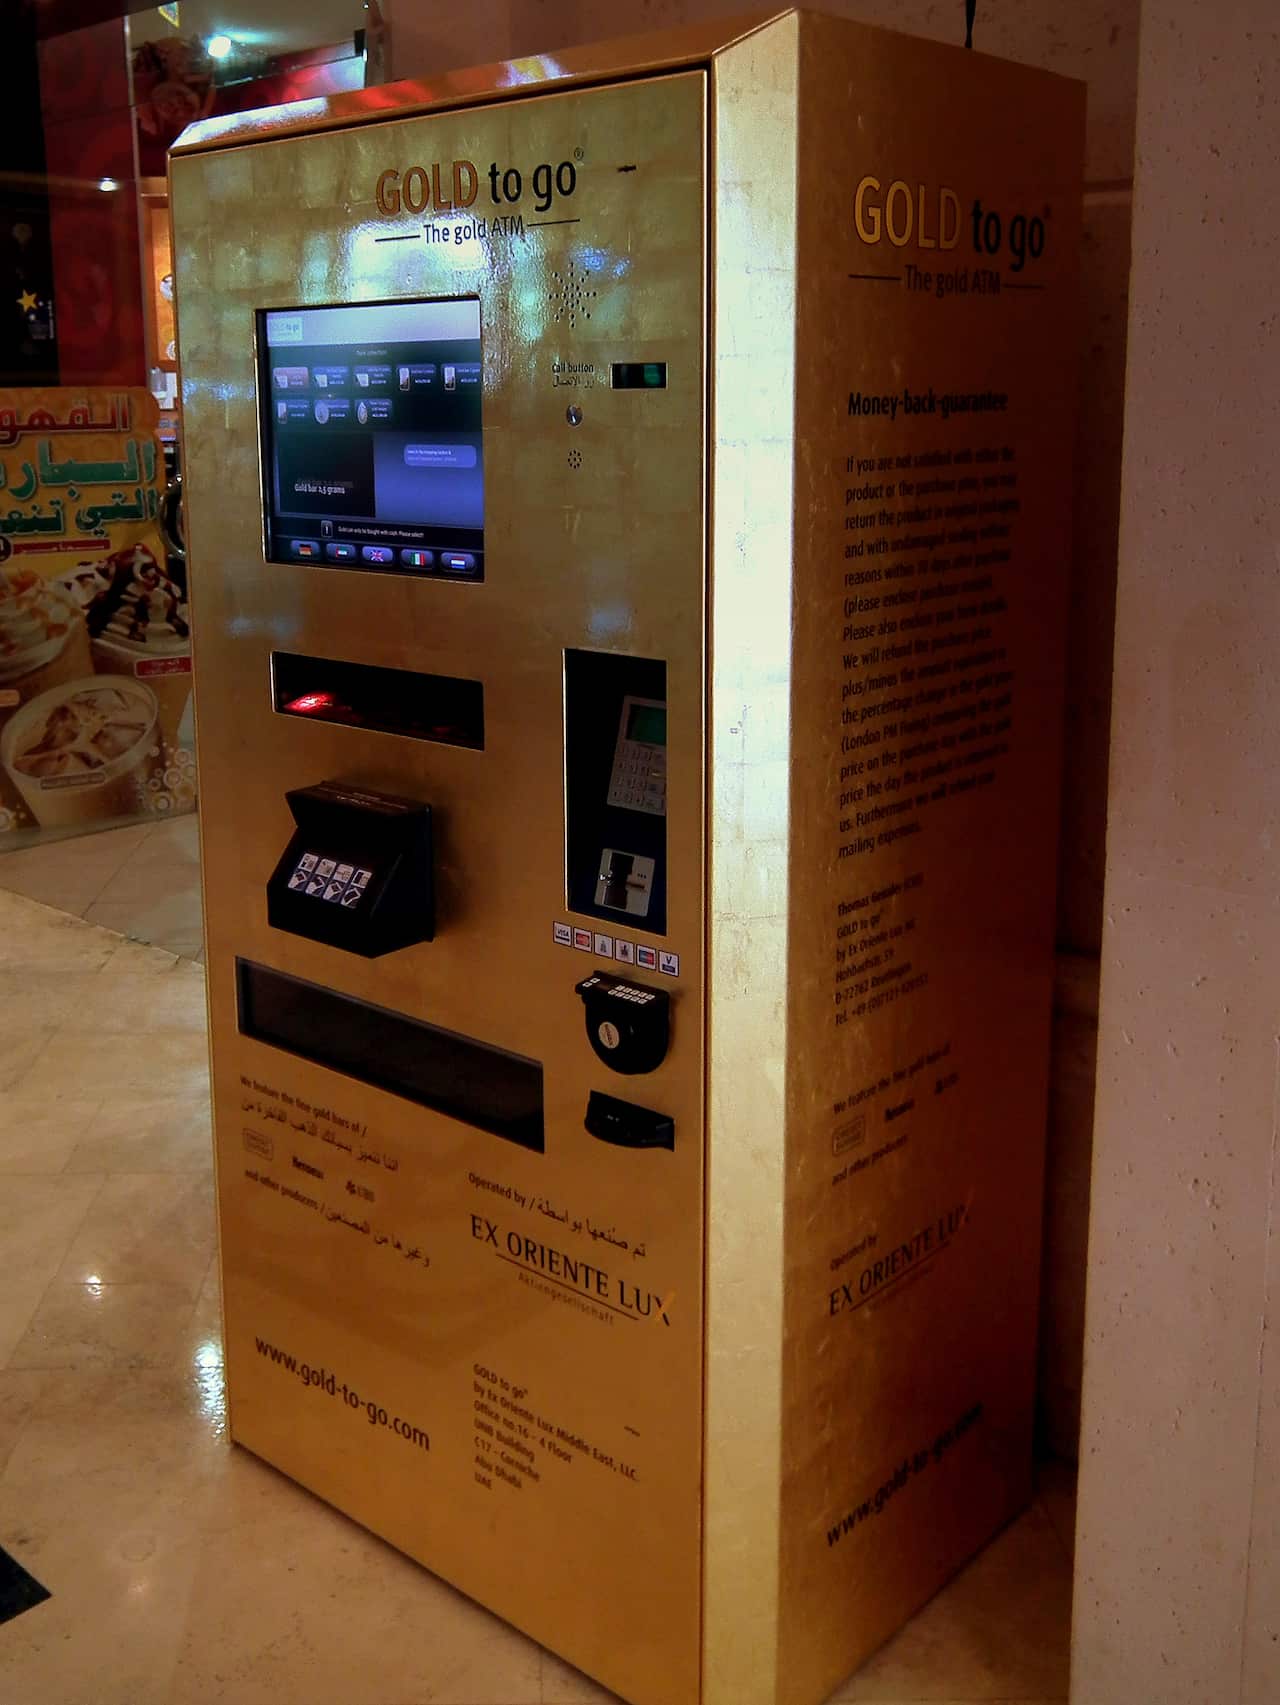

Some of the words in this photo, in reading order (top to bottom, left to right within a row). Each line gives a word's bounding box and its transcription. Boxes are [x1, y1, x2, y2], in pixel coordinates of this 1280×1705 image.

[376, 160, 479, 216] GOLD
[488, 162, 523, 204] to
[853, 175, 961, 251] GOLD
[971, 199, 1001, 254] to
[423, 224, 450, 244] The
[454, 219, 487, 245] gold
[491, 216, 525, 237] ATM
[904, 264, 932, 290] The
[935, 268, 968, 298] gold
[971, 270, 1001, 295] ATM
[567, 362, 594, 373] button
[847, 388, 1009, 421] Money-back-guarantee
[0, 393, 130, 447] القهو
[846, 456, 854, 473] If
[857, 460, 874, 476] you
[878, 459, 892, 472] are
[846, 483, 883, 505] product
[899, 480, 914, 497] the
[75, 486, 158, 537] التي
[845, 509, 875, 530] return
[879, 508, 894, 527] the
[844, 540, 864, 559] and
[867, 537, 888, 557] with
[844, 568, 881, 588] reasons
[844, 595, 880, 617] (please
[843, 621, 875, 641] Please
[878, 617, 897, 636] also
[843, 653, 858, 669] We
[862, 647, 879, 667] will
[842, 707, 860, 725] the
[841, 727, 880, 754] (London
[840, 759, 864, 781] price
[867, 756, 879, 770] on
[882, 749, 897, 767] the
[839, 787, 863, 809] price
[867, 780, 882, 798] the
[884, 776, 900, 792] day
[838, 835, 875, 859] mailing
[557, 929, 569, 937] VISA
[836, 921, 858, 939] GOLD
[836, 948, 845, 963] by
[468, 1172, 512, 1199] Operated
[514, 1189, 527, 1208] by
[470, 1213, 499, 1248] EX
[506, 1231, 609, 1297] ORIENTE
[618, 1279, 673, 1326] LUX
[829, 1281, 853, 1316] EX
[859, 1226, 934, 1295] ORIENTE
[473, 1362, 498, 1385] GOLD
[500, 1377, 510, 1391] to
[255, 1336, 430, 1451] www.gold-to-go.com
[473, 1380, 485, 1399] by
[487, 1389, 498, 1403] Ex
[500, 1396, 535, 1424] Oriente
[537, 1416, 554, 1433] Lux
[592, 1447, 617, 1472] East,
[474, 1399, 500, 1423] Office
[547, 1440, 573, 1464] Floor
